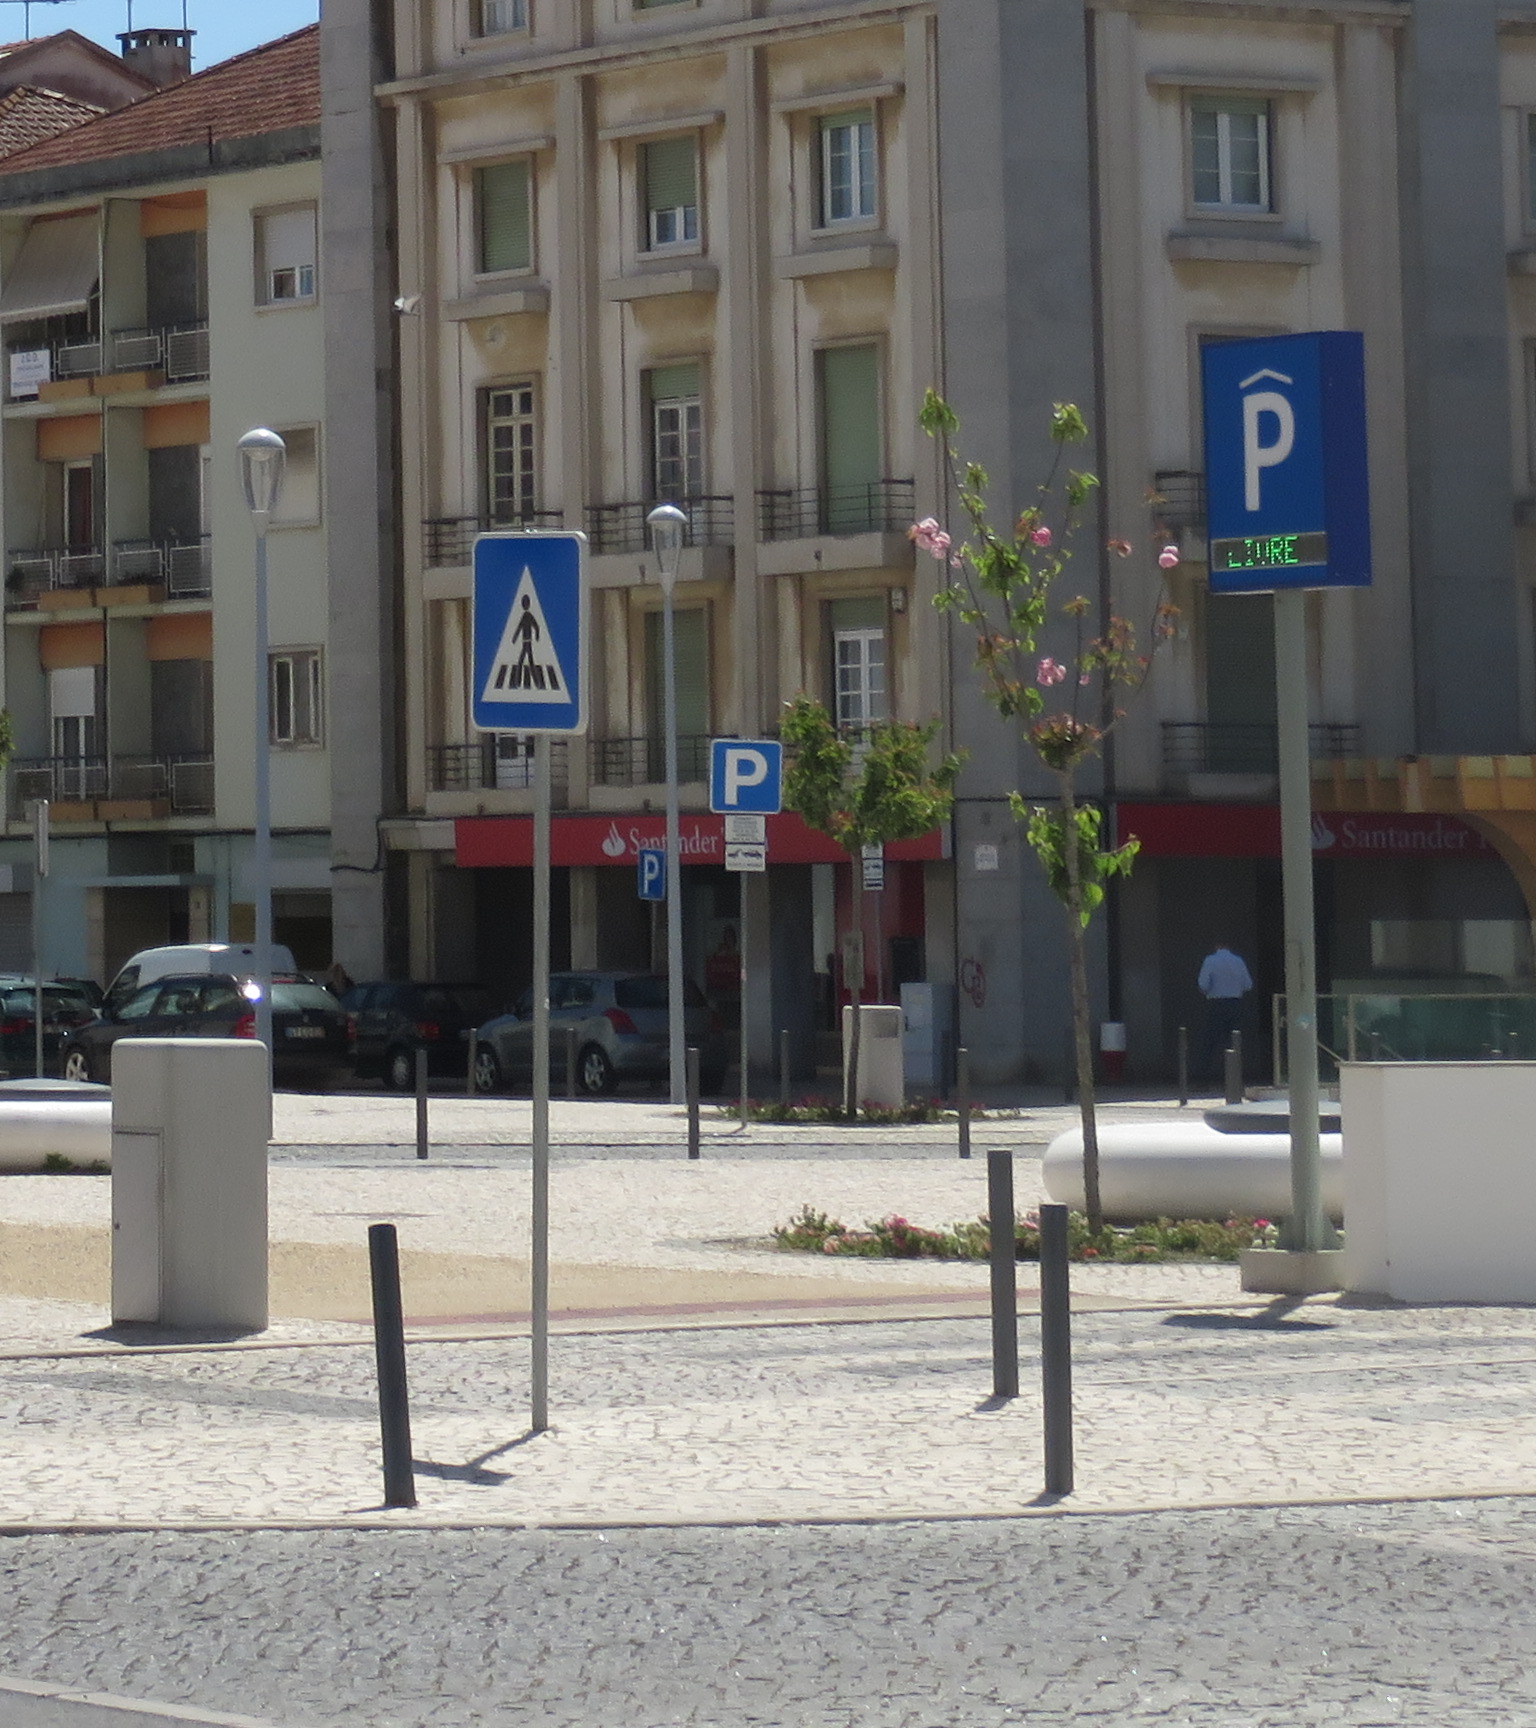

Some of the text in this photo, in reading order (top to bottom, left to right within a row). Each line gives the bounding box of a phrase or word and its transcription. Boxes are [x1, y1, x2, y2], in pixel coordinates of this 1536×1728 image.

[1242, 391, 1294, 512] P
[1227, 536, 1299, 568] LIVRE
[725, 748, 768, 805] P
[630, 825, 718, 855] Santnder
[1341, 820, 1468, 850] Santander
[643, 853, 659, 895] P
